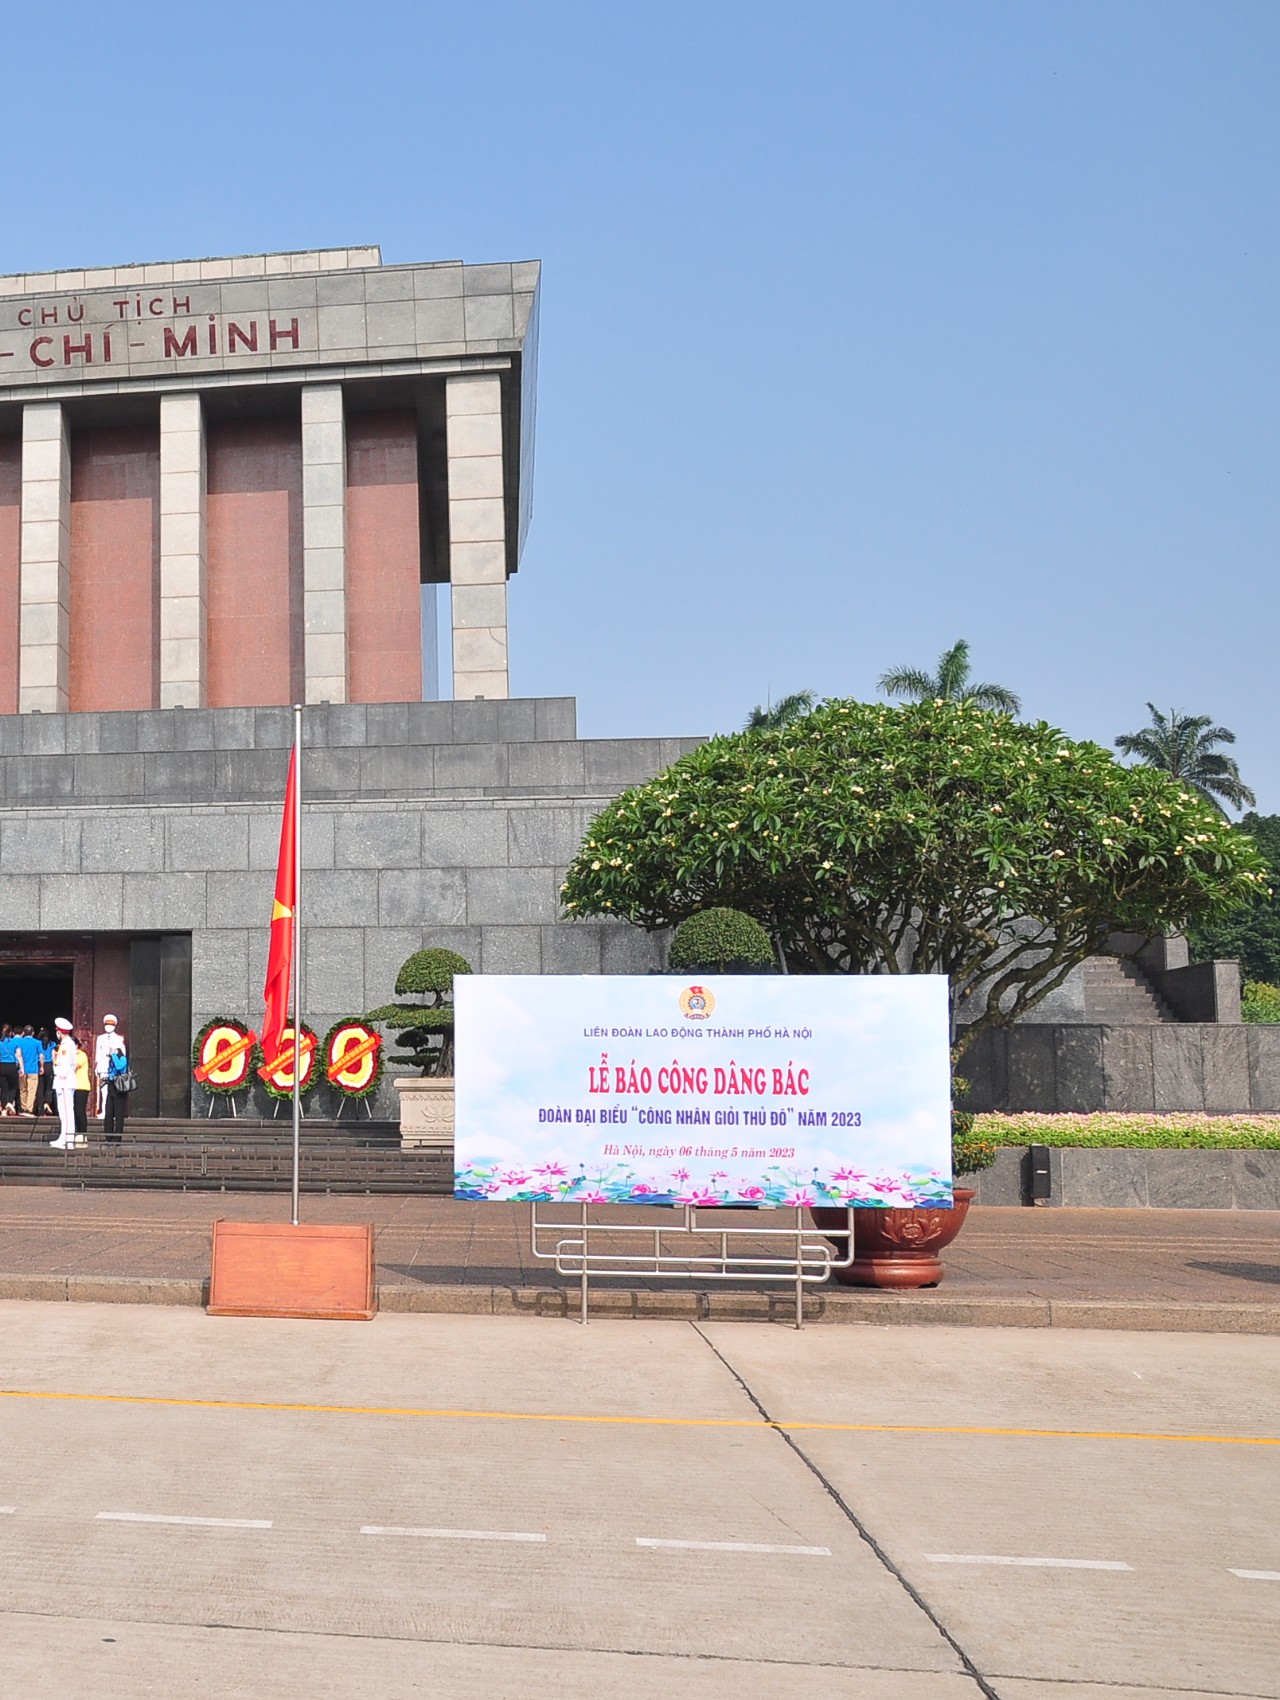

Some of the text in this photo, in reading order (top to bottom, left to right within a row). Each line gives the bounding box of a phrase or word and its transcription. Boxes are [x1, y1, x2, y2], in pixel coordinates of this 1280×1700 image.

[18, 293, 191, 326] CHỦ TỊCH
[30, 323, 114, 368] CHÍ
[584, 1026, 812, 1040] LIÊN ĐOÀN LAO ĐỘNG THÀNH PHỐ HÀ NỘI
[589, 1053, 809, 1095] LỄ BÁO CÔNG DÂNG BÁC
[539, 1106, 572, 1123] ĐOÀN
[576, 1109, 596, 1126] ĐẠI
[600, 1104, 627, 1124] BIỂU
[676, 1107, 710, 1125] NHÂN
[715, 1106, 739, 1126] GIỎI
[743, 1106, 766, 1126] THỦ
[798, 1109, 827, 1126] NĂM
[831, 1112, 862, 1127] 2023
[603, 1145, 795, 1159] Hà Nội, ngày 06 tháng 5 năm 2023
